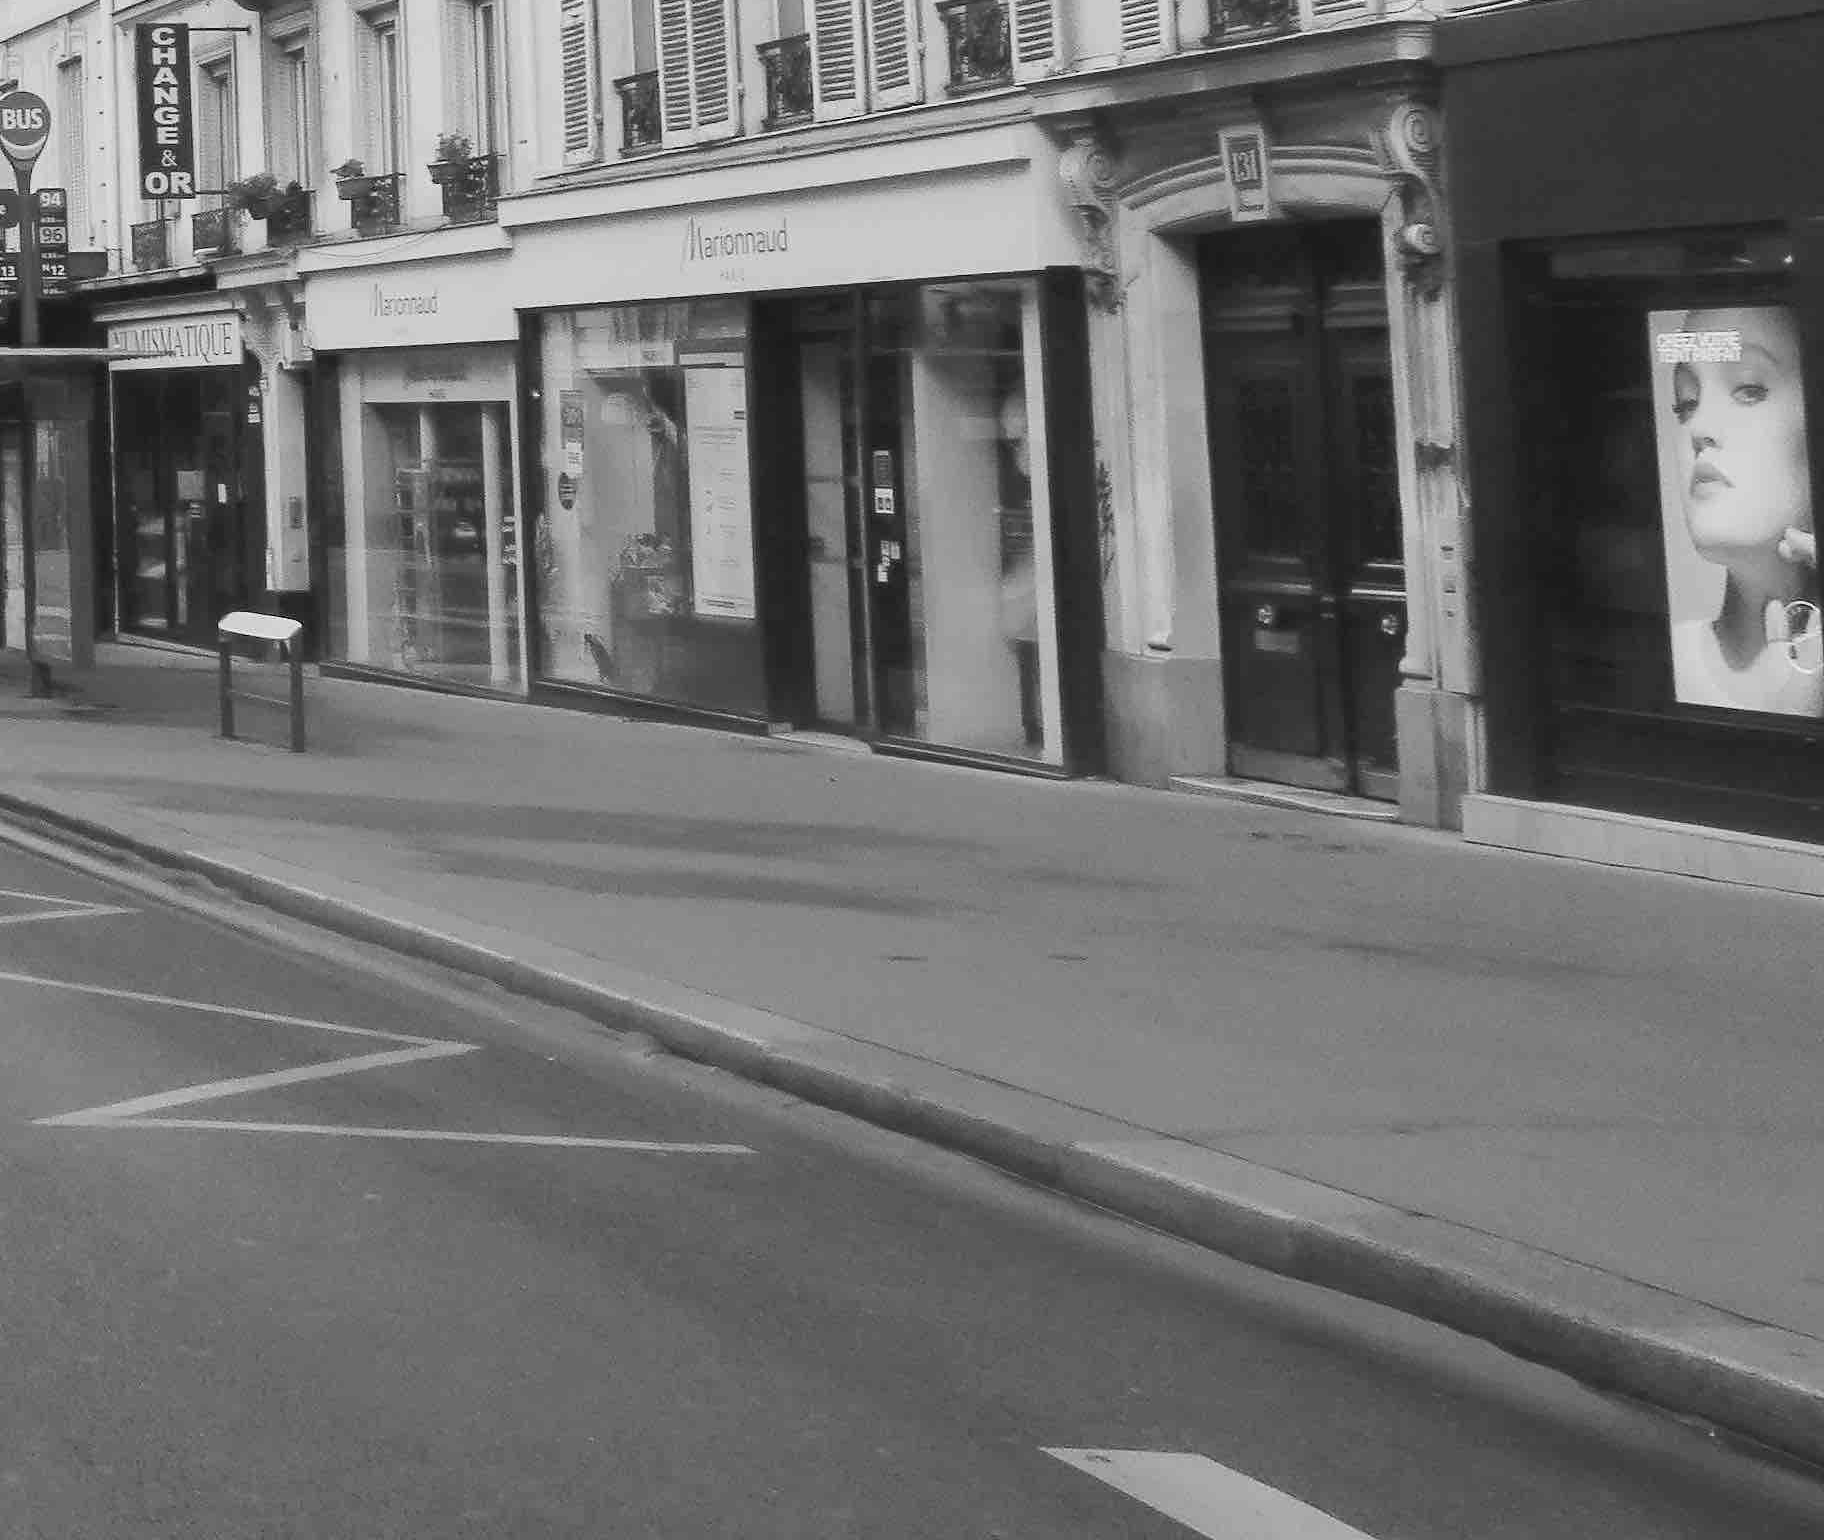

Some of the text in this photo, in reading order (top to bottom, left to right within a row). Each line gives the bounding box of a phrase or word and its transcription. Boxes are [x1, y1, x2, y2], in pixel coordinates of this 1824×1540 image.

[1, 108, 43, 130] BUS
[145, 27, 193, 195] CHANGE & OR
[1231, 148, 1258, 183] 131
[40, 192, 62, 208] 94
[683, 216, 788, 262] Marionnaud
[372, 283, 440, 317] Marionnaud
